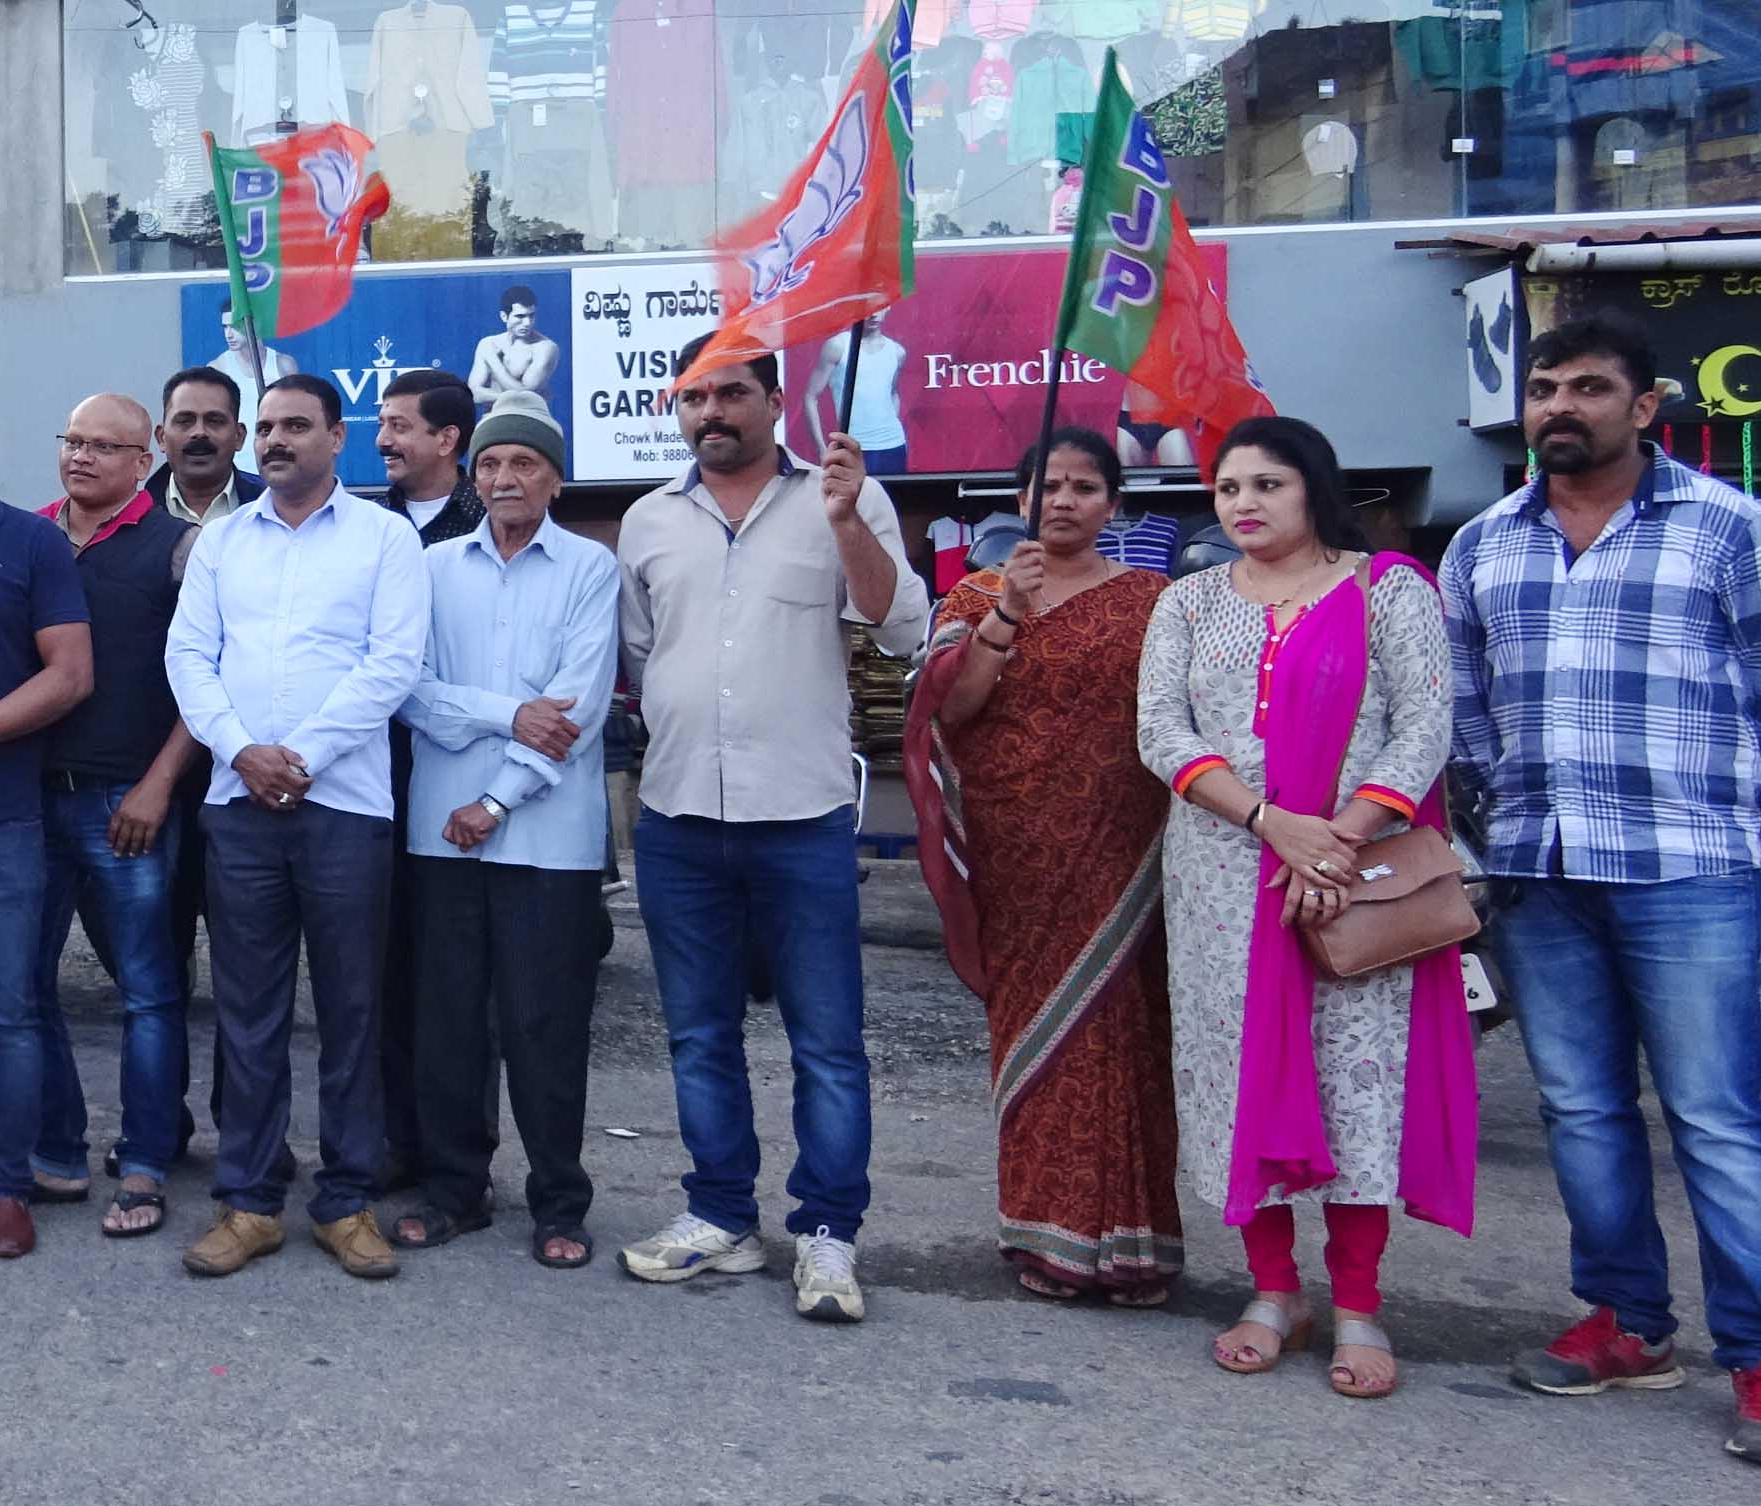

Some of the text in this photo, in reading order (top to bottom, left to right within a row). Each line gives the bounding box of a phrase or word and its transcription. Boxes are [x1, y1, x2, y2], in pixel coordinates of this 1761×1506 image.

[231, 168, 279, 292] BJP
[1092, 109, 1171, 318] BJP
[923, 349, 1106, 390] Frenchie
[590, 389, 678, 418] GARM
[615, 430, 688, 444] Chowk Made
[633, 448, 694, 461] Mob: 98806
